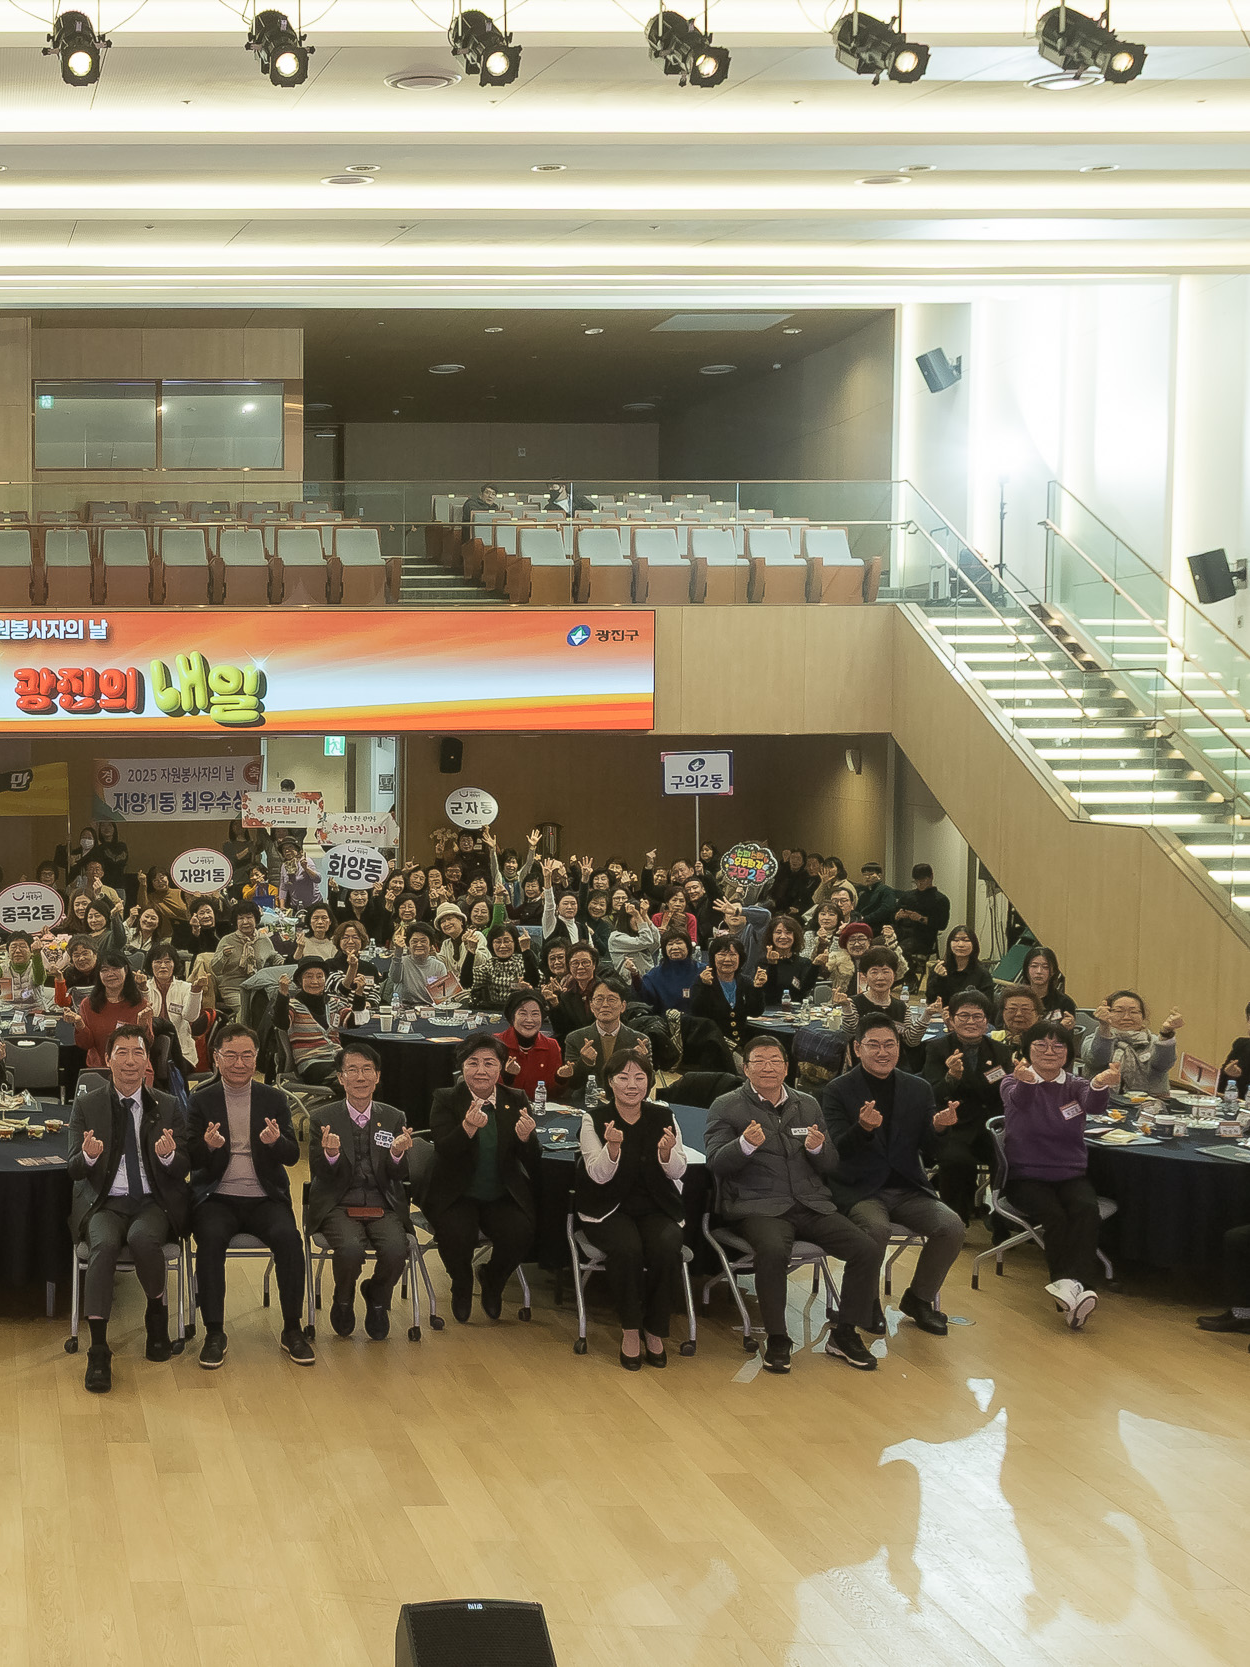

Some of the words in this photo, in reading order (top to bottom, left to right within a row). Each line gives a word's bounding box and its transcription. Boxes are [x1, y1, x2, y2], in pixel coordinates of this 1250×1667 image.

[88, 619, 108, 640] 날
[595, 629, 639, 642] 광진구
[14, 667, 138, 711] 광진의
[150, 651, 261, 723] 내일
[10, 772, 31, 789] 만
[101, 769, 114, 784] 경
[127, 768, 158, 783] 2025
[160, 766, 222, 783] 자원봉사자의
[224, 765, 235, 781] 날
[670, 774, 724, 789] 구의2동
[113, 791, 176, 813] 자양1동
[257, 804, 310, 815] 축하드립니다!
[450, 801, 492, 815] 군자동
[331, 823, 387, 836] 축하드립니다!
[179, 868, 225, 883] 자양1동
[327, 853, 382, 883] 화양동
[2, 904, 55, 923] 중곡2동
